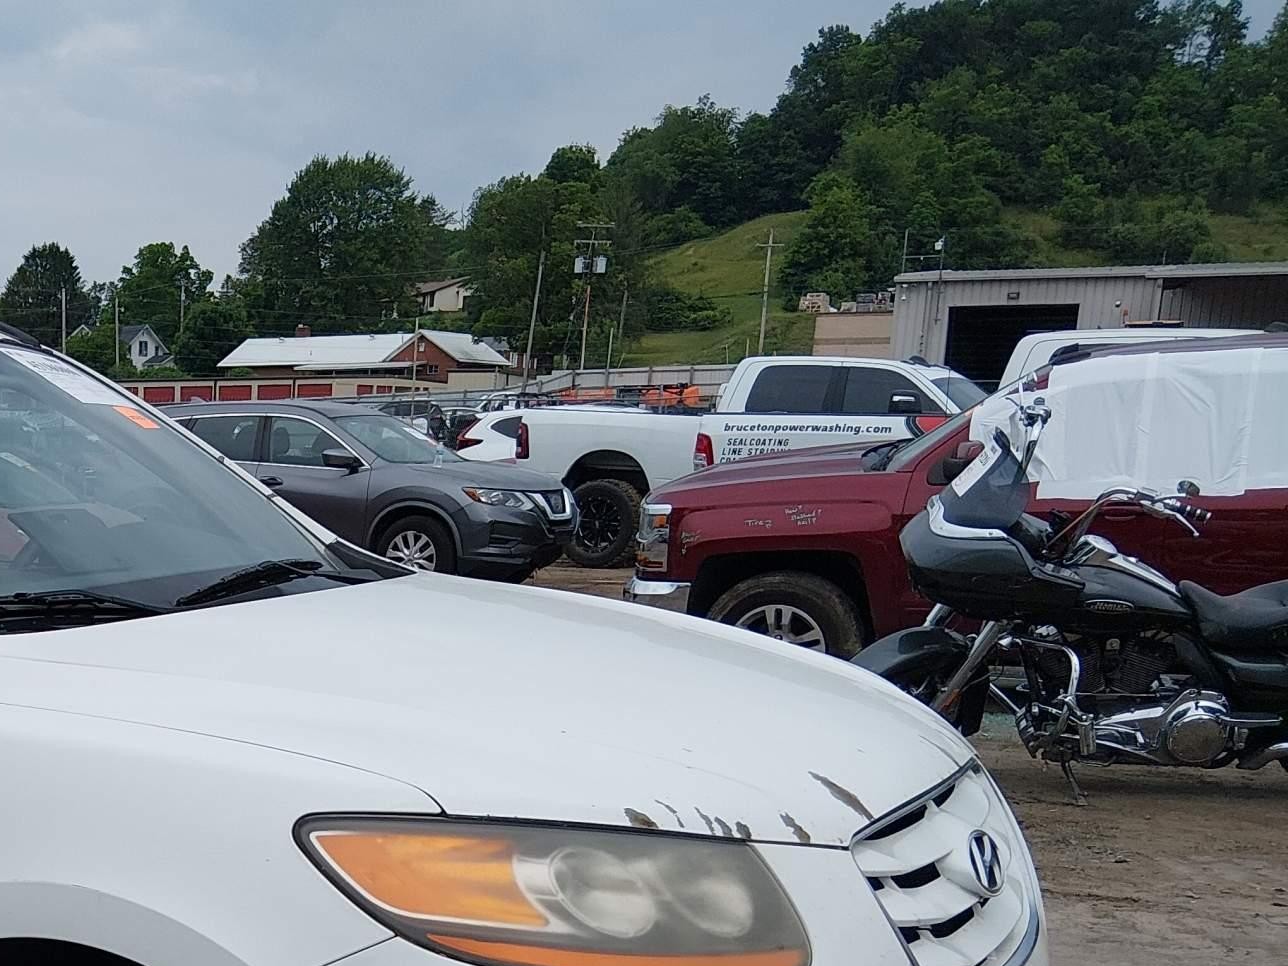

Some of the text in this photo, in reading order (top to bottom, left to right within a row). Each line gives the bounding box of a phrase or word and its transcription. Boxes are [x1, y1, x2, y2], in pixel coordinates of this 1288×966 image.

[724, 423, 892, 434] brucetonpowerwashing.com
[727, 438, 790, 447] SEALCOATING
[722, 448, 743, 456] LINE
